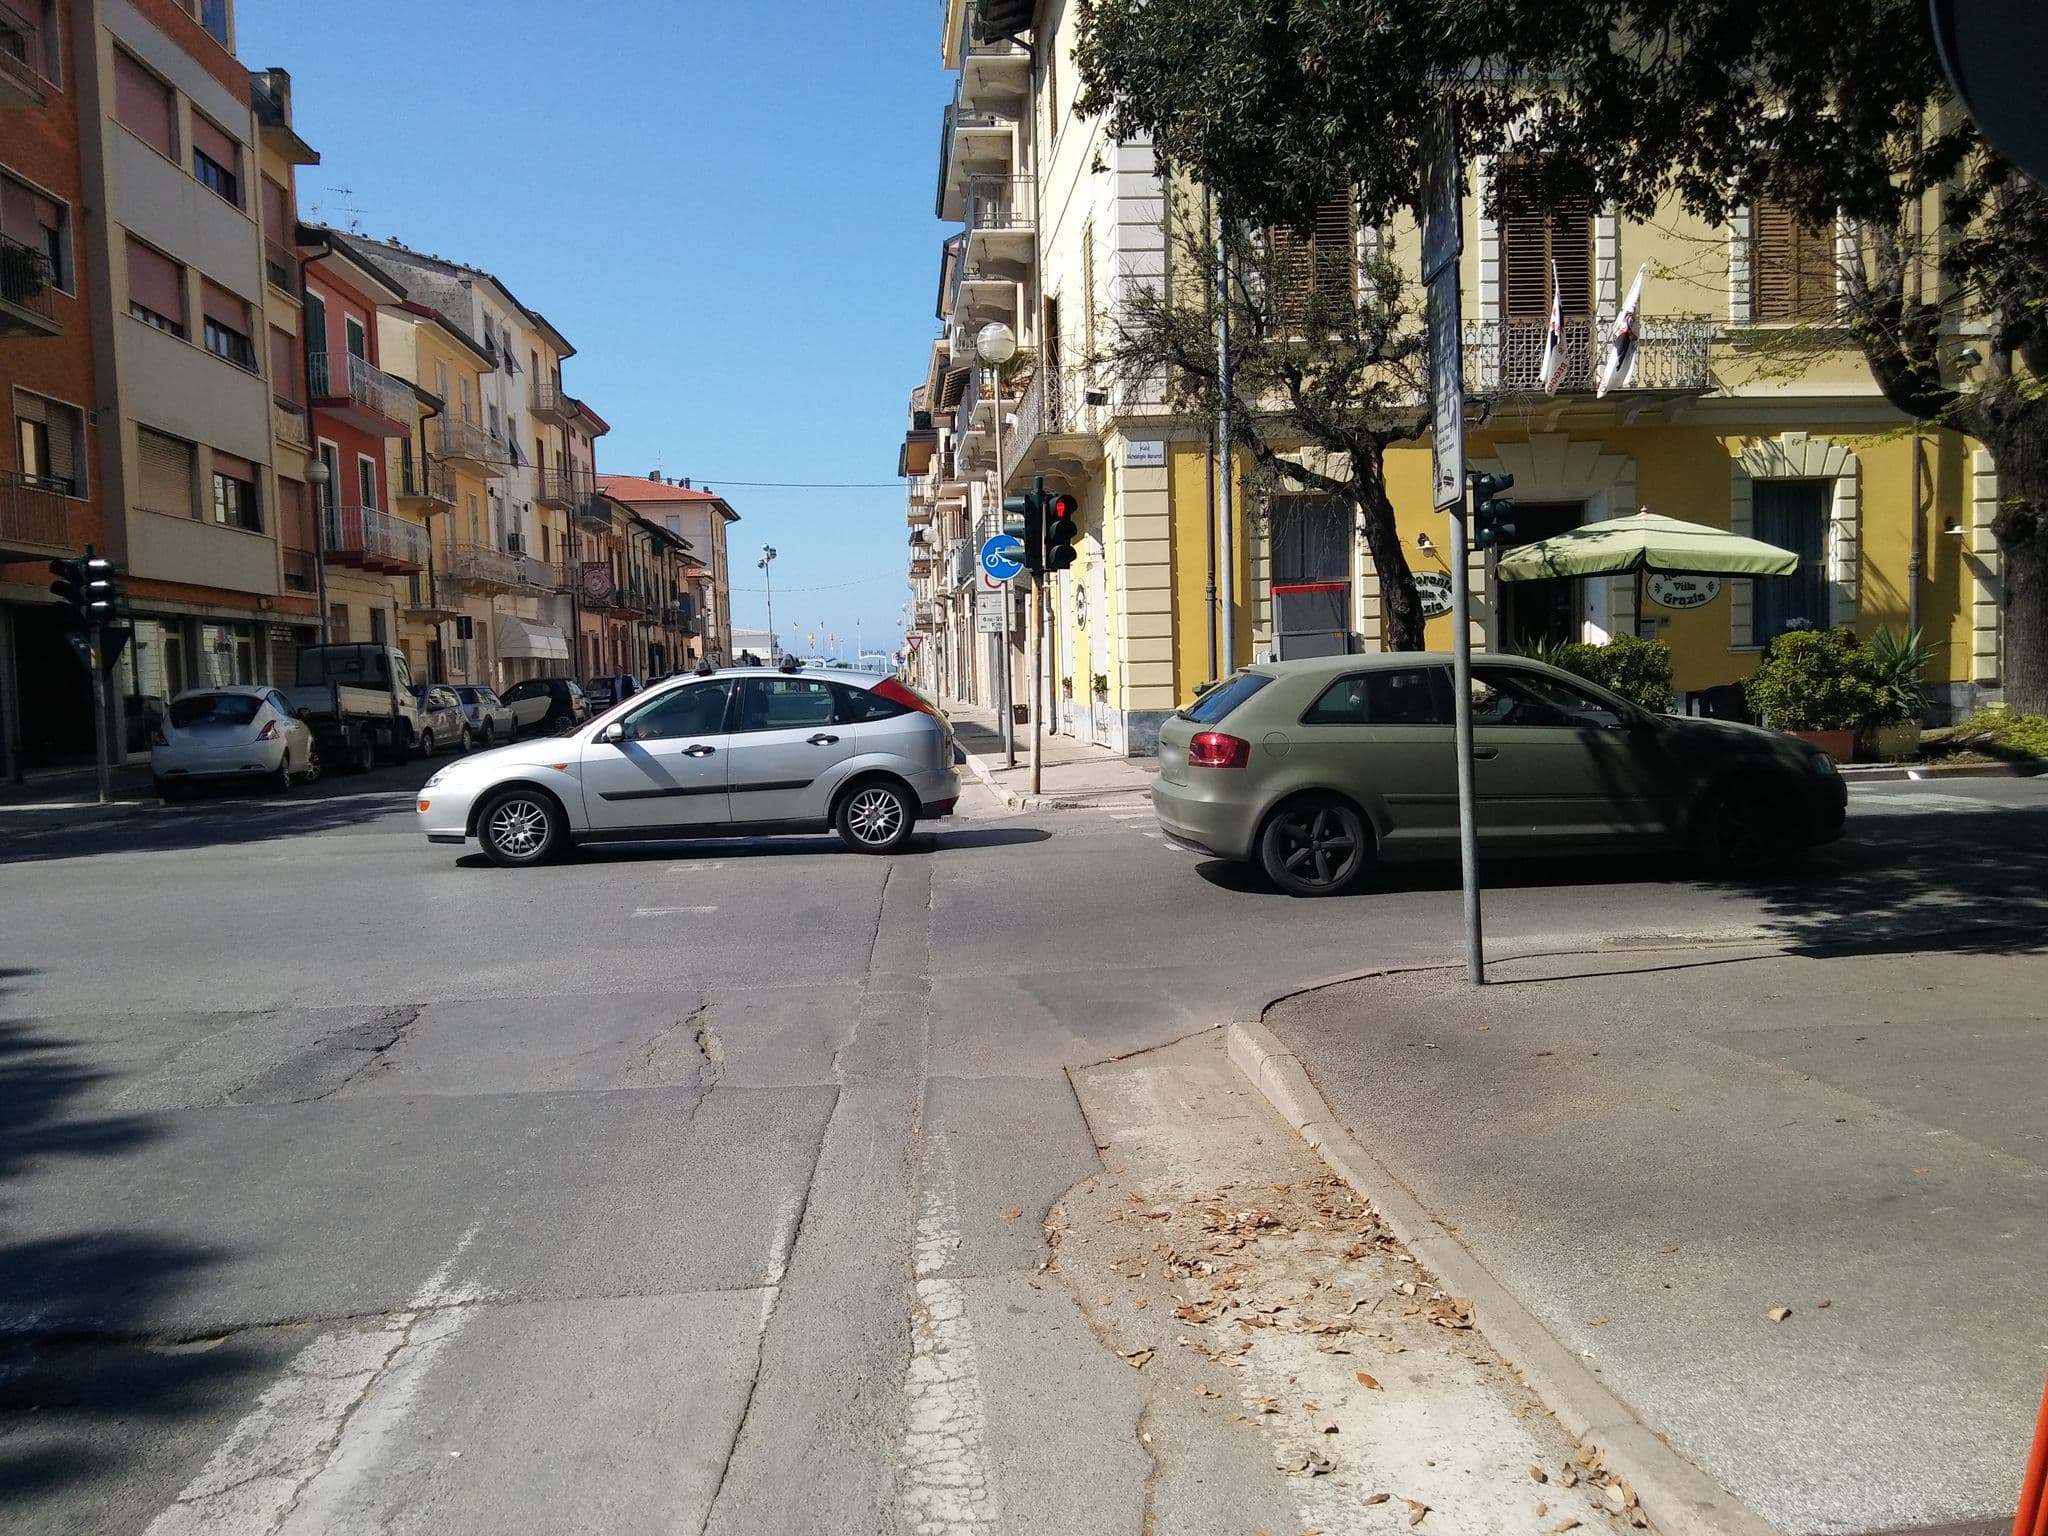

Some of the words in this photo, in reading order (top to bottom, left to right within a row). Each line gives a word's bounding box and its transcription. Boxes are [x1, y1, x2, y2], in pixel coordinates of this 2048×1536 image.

[1673, 582, 1696, 591] Villa
[1419, 589, 1435, 599] illa
[1663, 593, 1706, 606] Grazia
[1423, 602, 1445, 613] zia
